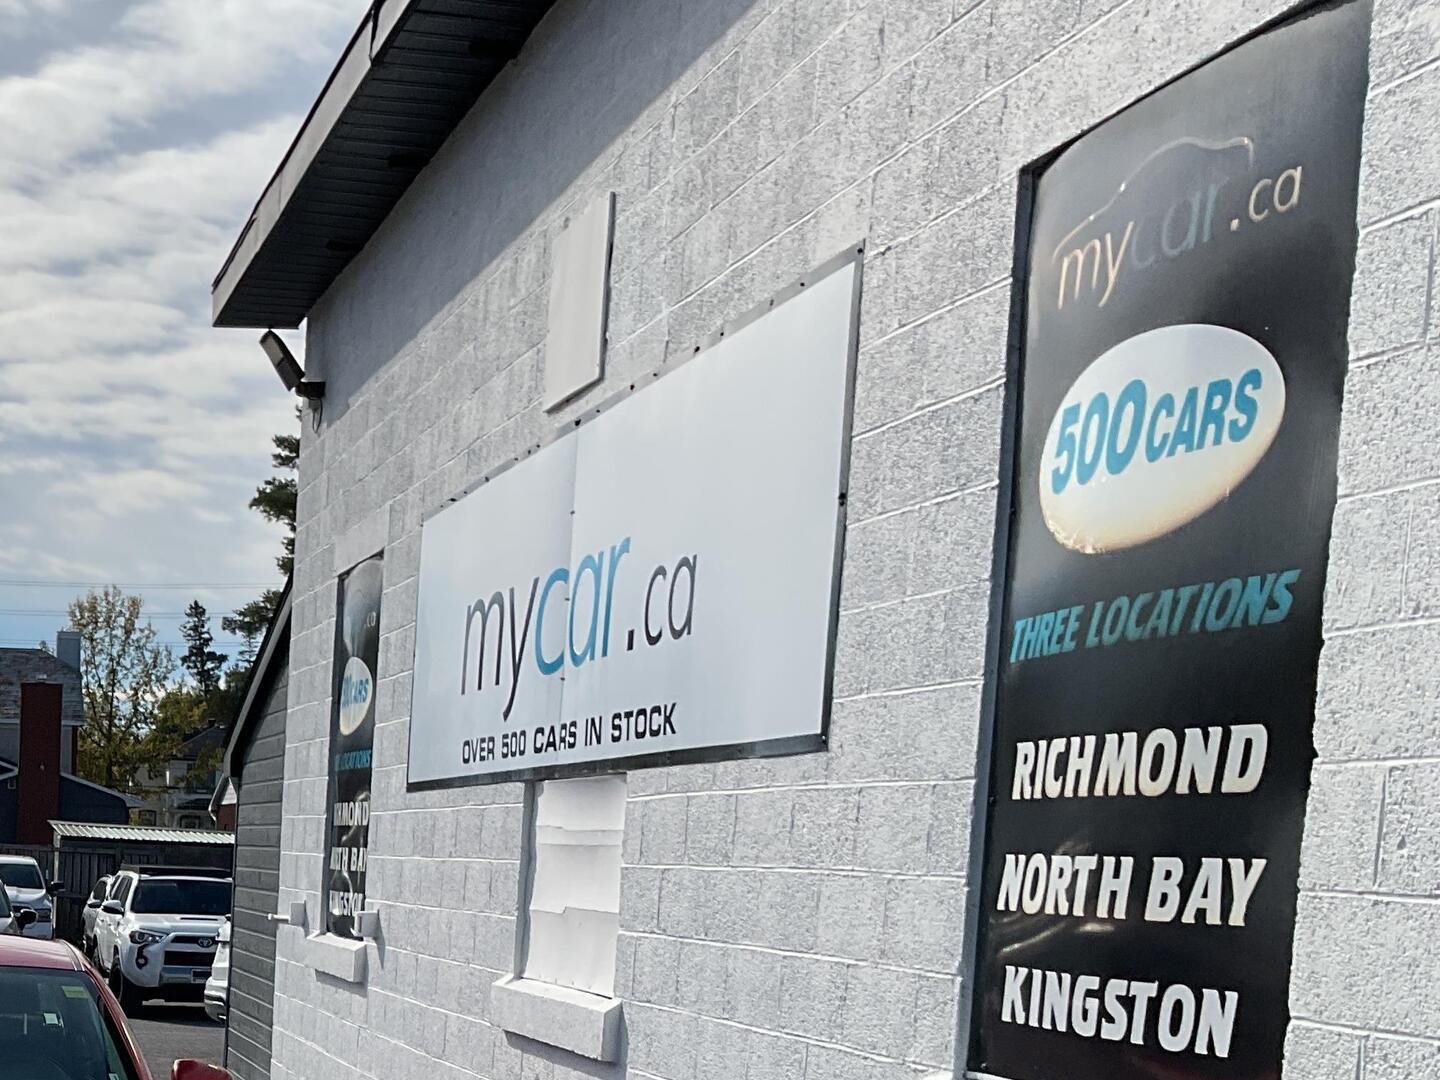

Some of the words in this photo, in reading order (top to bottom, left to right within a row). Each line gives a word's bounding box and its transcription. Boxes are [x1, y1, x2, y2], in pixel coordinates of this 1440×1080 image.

[461, 537, 698, 721] mycar.ca
[1009, 602, 1081, 663] THREE
[1084, 569, 1303, 648] LOCATIONS
[462, 736, 495, 764] OVER
[501, 730, 527, 759] 500
[533, 721, 578, 754] CARS
[584, 716, 603, 747] IN
[611, 702, 678, 743] STOCK
[1012, 723, 1268, 800] RICHMOND
[334, 801, 369, 826] MOND
[995, 853, 1134, 919] NORTH
[1144, 856, 1268, 927] BAY
[1000, 965, 1239, 1059] KINGSTON
